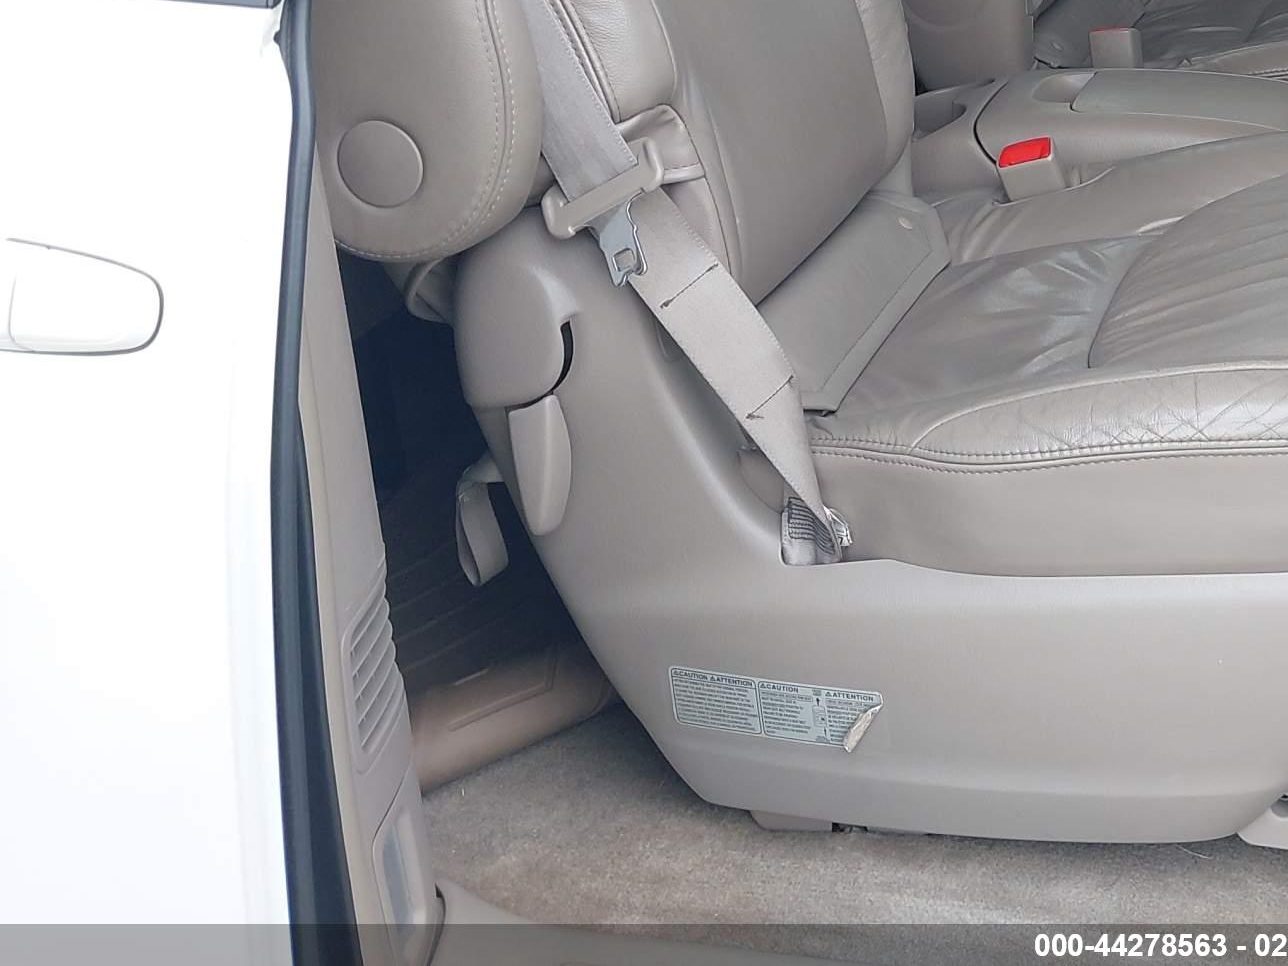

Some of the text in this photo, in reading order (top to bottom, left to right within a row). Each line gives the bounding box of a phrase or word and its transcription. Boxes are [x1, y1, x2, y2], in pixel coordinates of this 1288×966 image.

[679, 671, 753, 687] CAUTION ATTENTION
[766, 684, 799, 693] CAUTION
[832, 692, 874, 702] ATTENTION
